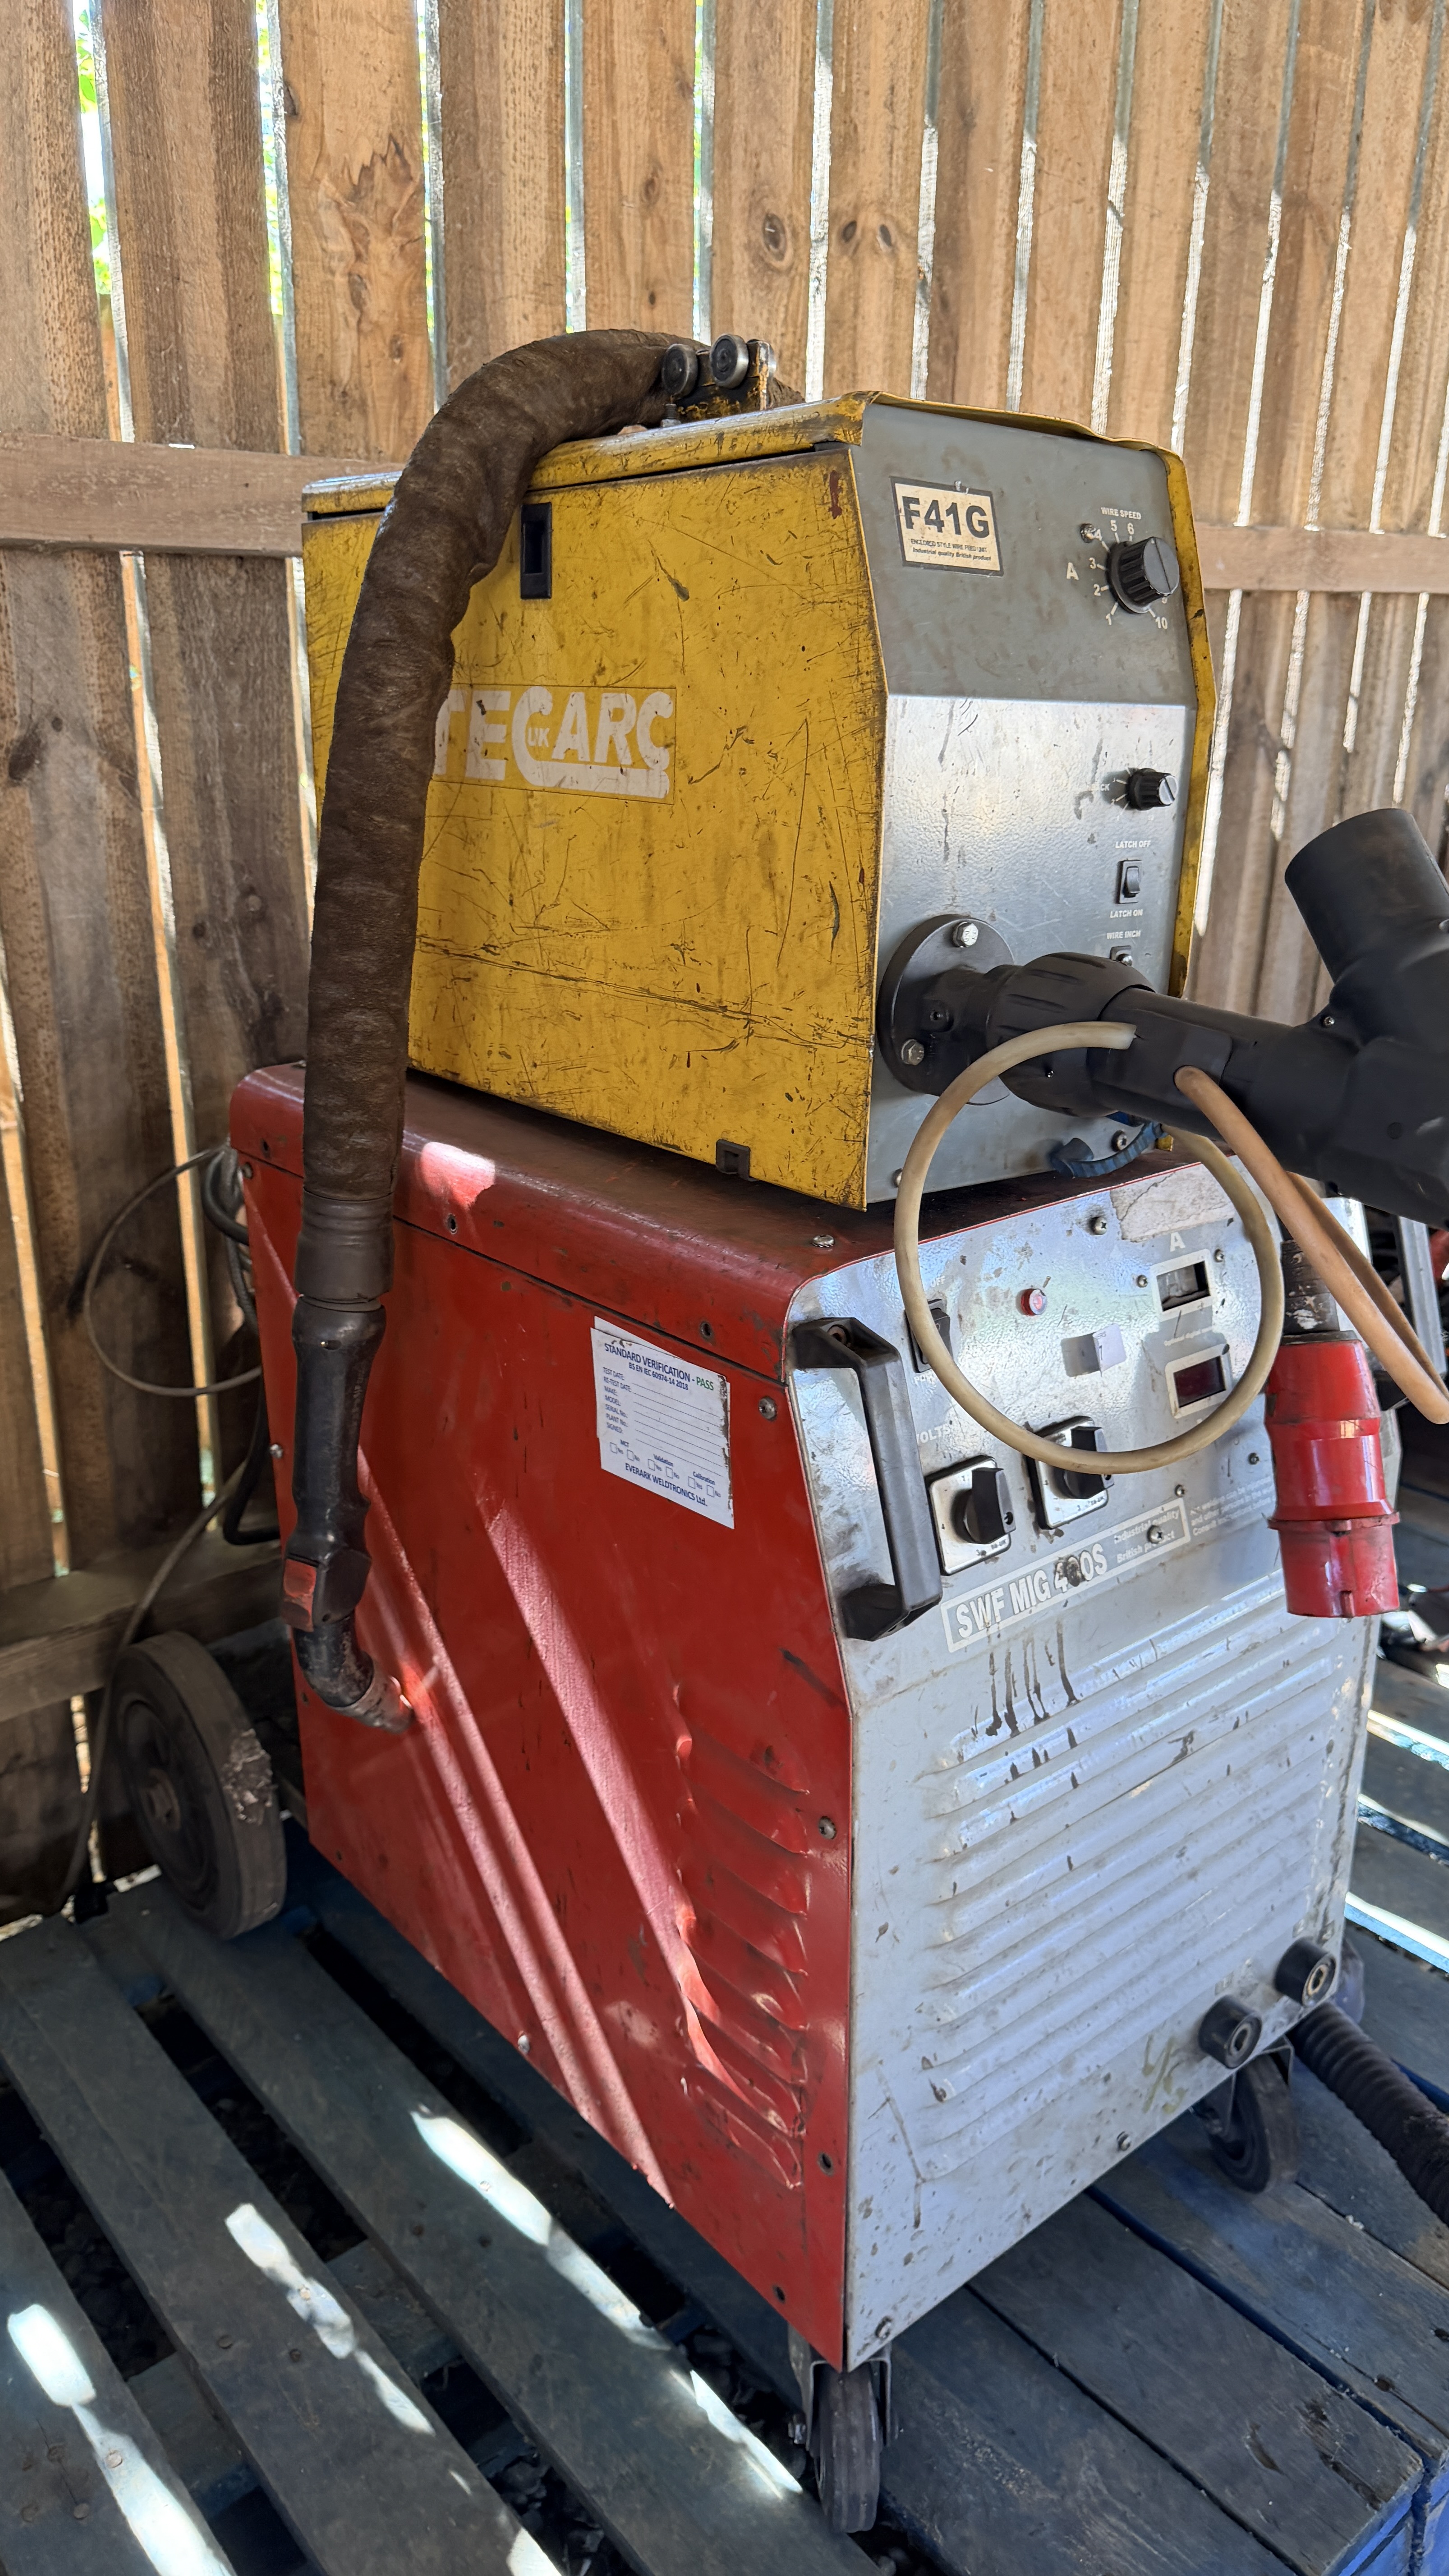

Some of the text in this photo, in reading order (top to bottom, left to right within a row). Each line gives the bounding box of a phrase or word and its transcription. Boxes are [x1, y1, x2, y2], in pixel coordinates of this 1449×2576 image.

[902, 496, 990, 538] F41G
[1101, 507, 1141, 520] WIRE SPEED
[1110, 520, 1117, 531] 5
[1127, 523, 1134, 535] 6
[1089, 557, 1096, 569] 3
[1066, 562, 1079, 580] A
[1093, 584, 1101, 596] 2
[1106, 613, 1112, 625] 1
[1155, 616, 1168, 629] 10
[527, 727, 550, 747] UK
[1110, 910, 1132, 918] LATCH
[1170, 1232, 1186, 1252] A
[931, 1276, 945, 1287] OFF
[604, 1343, 641, 1363] STANDARD
[642, 1356, 690, 1382] VERIFICATION
[696, 1377, 714, 1390] PASS
[652, 1475, 695, 1500] WELDTRONICS
[1114, 1520, 1151, 1544] Industrial
[1152, 1510, 1180, 1525] quality
[1117, 1545, 1143, 1563] British
[956, 1587, 1005, 1638] SWF
[1009, 1570, 1051, 1615] MIG
